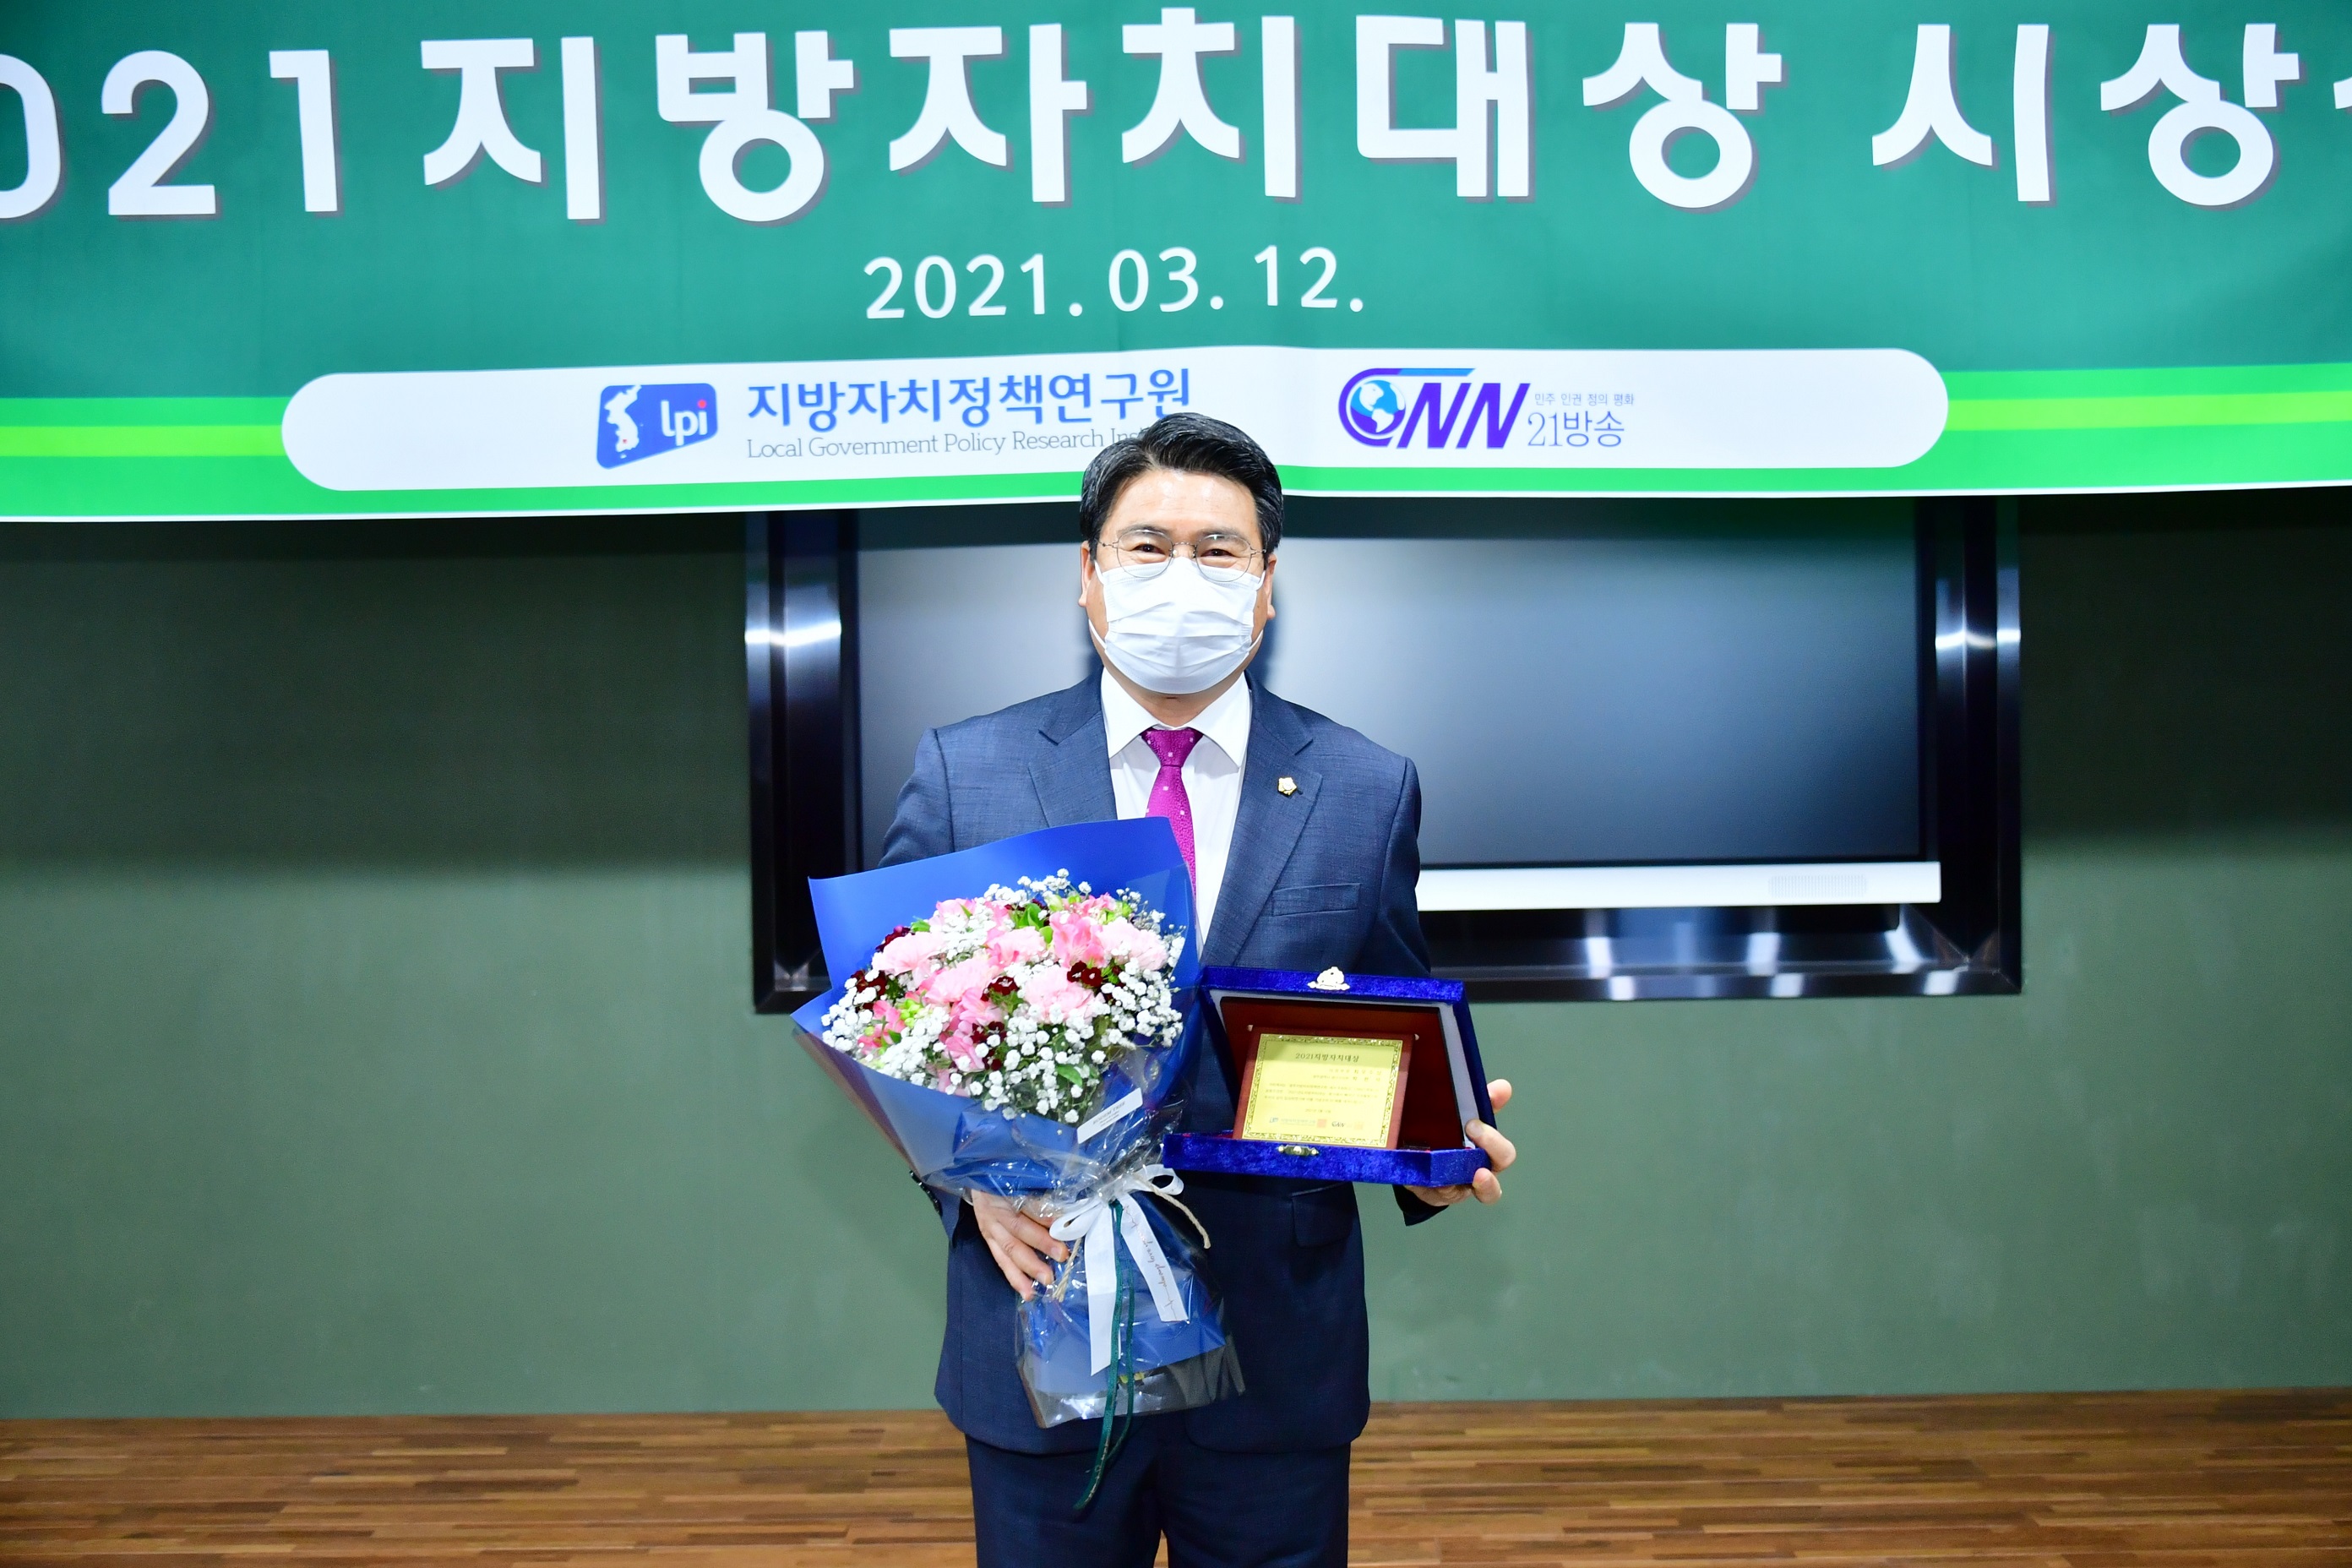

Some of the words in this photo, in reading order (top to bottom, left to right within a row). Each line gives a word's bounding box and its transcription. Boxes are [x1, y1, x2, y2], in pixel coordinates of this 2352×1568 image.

[1872, 24, 2352, 206] 시상
[748, 368, 1190, 433] 지방자치정책연구원
[1534, 393, 1556, 406] 민주
[1560, 393, 1582, 407] 인권
[1587, 393, 1609, 407] 정의
[1614, 393, 1636, 407] 평화
[747, 438, 803, 459] Local
[808, 435, 939, 457] Government
[944, 432, 1007, 455] Policy
[1011, 428, 1105, 450] Research
[1527, 410, 1626, 448] 21방송
